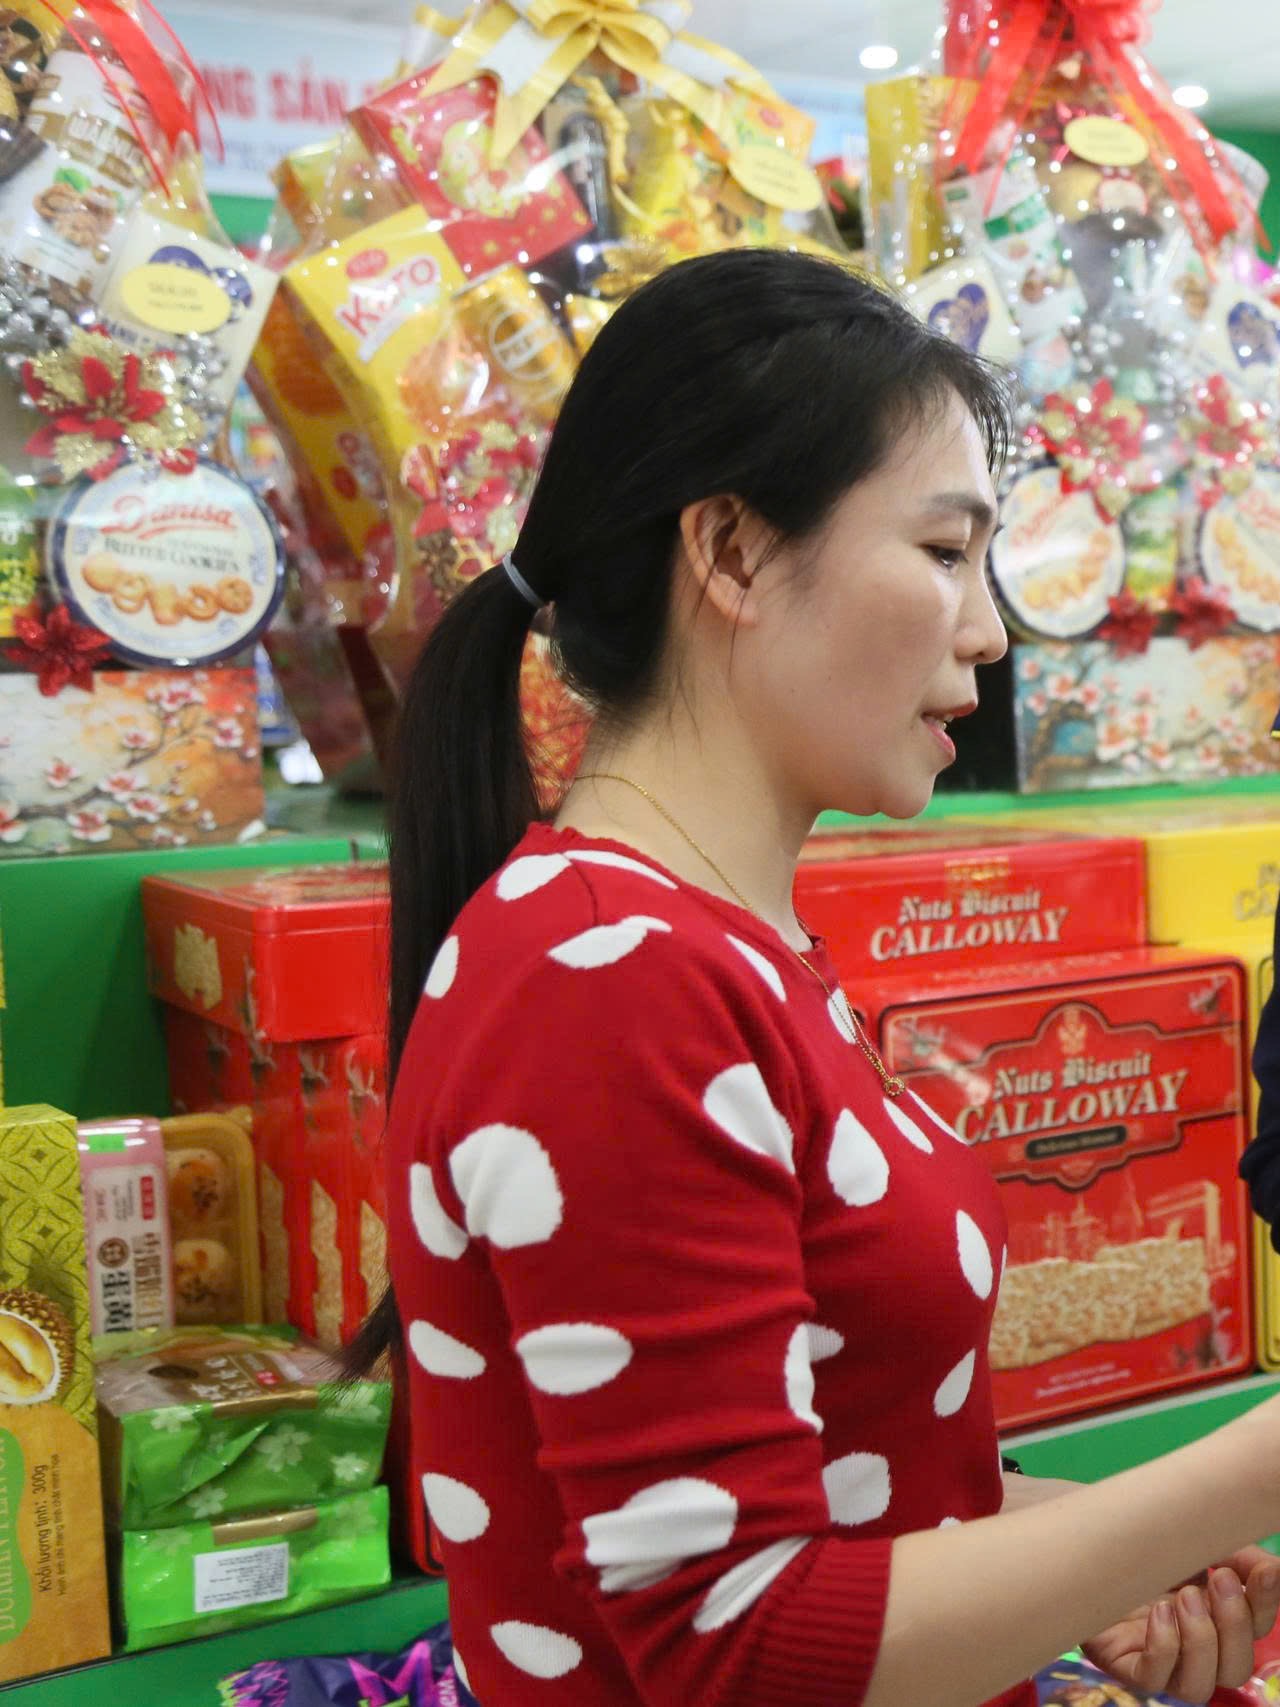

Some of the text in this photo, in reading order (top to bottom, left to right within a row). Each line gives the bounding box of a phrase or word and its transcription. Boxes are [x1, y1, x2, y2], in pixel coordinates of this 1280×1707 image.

[898, 888, 1041, 926] Nuts Biscuit
[869, 905, 1069, 962] CALLOWAY
[992, 1051, 1152, 1101] Nuts Biscuit
[954, 1070, 1189, 1147] CALLOWAY
[31, 1464, 48, 1494] 300g
